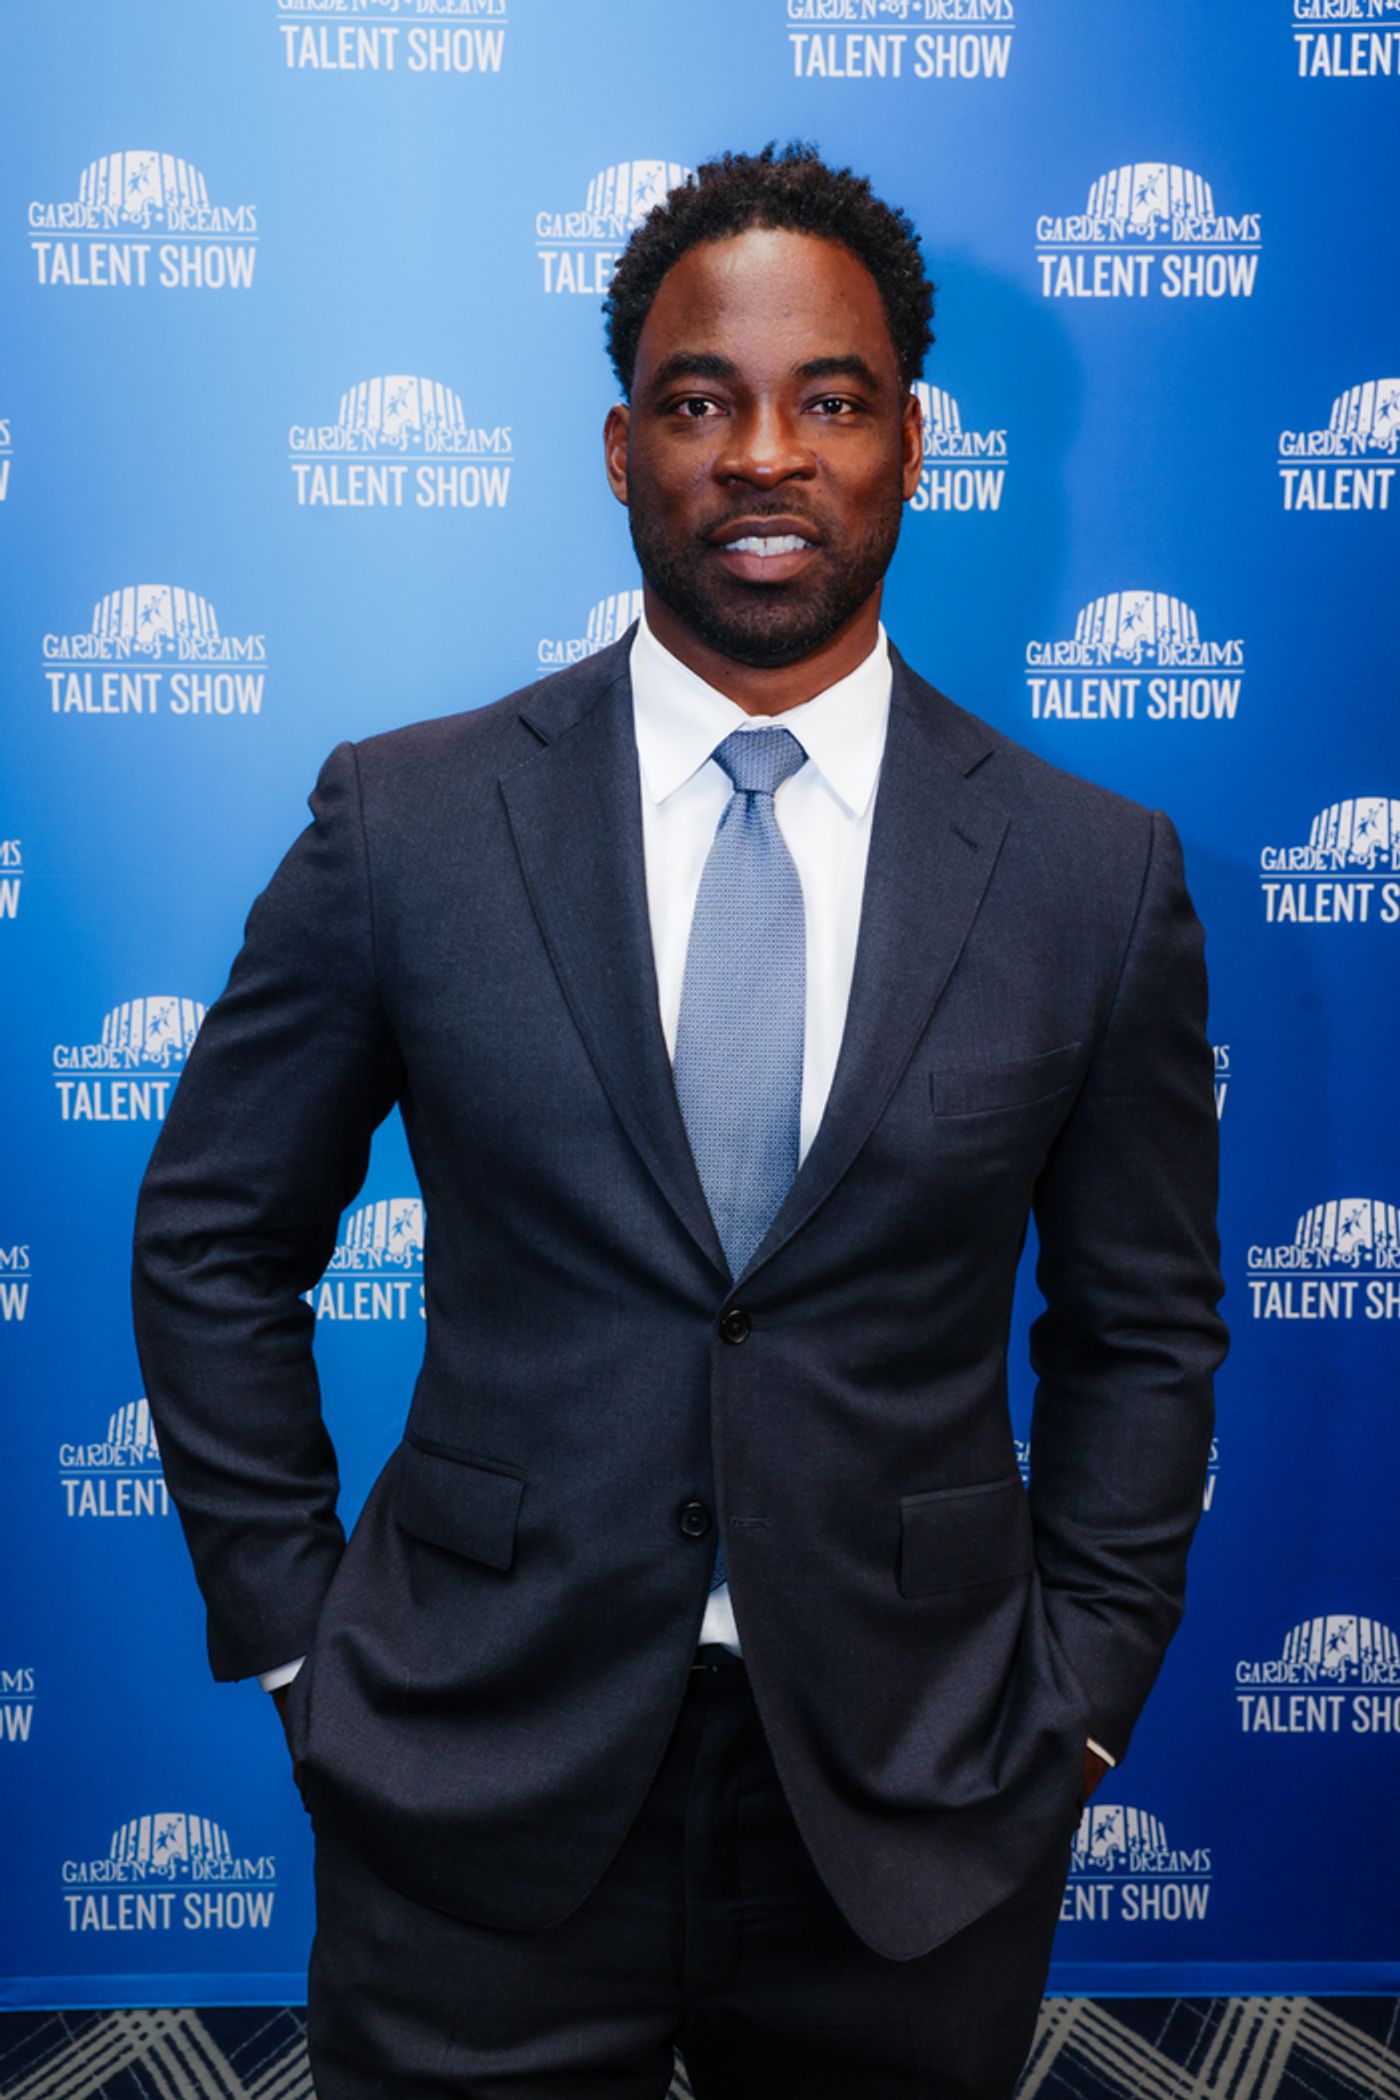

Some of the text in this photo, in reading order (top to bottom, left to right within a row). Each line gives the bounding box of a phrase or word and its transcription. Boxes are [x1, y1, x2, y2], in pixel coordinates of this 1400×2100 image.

[280, 25, 504, 72] TALENT SHOW
[789, 34, 1011, 78] TALENT SHOW
[28, 201, 118, 229] GARDEN
[167, 203, 256, 232] DREAMS
[536, 211, 625, 238] GARDEN
[1036, 213, 1124, 241] GARDEN
[1171, 213, 1260, 242] DREAMS
[32, 242, 256, 288] TALENT SHOW
[538, 251, 622, 293] TALE
[1037, 254, 1257, 297] TALENT SHOW
[290, 425, 379, 451] GARDEN
[424, 425, 511, 453] DREAMS
[1279, 431, 1366, 456] GARDEN
[292, 464, 510, 507] TALENT SHOW
[911, 470, 1004, 512] SHOW
[1280, 469, 1395, 510] TALENT
[43, 633, 132, 659] GARDEN
[178, 635, 265, 660] DREAMS
[1026, 640, 1111, 666] GARDEN
[1157, 640, 1243, 666] DREAMS
[46, 672, 264, 714] TALENT SHOW
[1027, 678, 1241, 719] TALENT SHOW
[1261, 847, 1346, 870] GARDEN
[1262, 883, 1374, 922] TALENT
[53, 1044, 140, 1069] GARDEN
[56, 1082, 170, 1120] TALENT
[1248, 1245, 1330, 1268] GARDEN
[306, 1282, 412, 1320] ALENT
[1248, 1282, 1359, 1318] TALENT
[60, 1443, 144, 1466] GARDEN
[1236, 1661, 1317, 1683] GARDEN
[1237, 1696, 1345, 1732] TALENT
[63, 1859, 146, 1882] GARDEN
[191, 1857, 275, 1880] DREAMS
[1129, 1849, 1210, 1871] DREAMS
[64, 1892, 274, 1931] TALENT SHOW
[1122, 1884, 1209, 1920] SHOW
